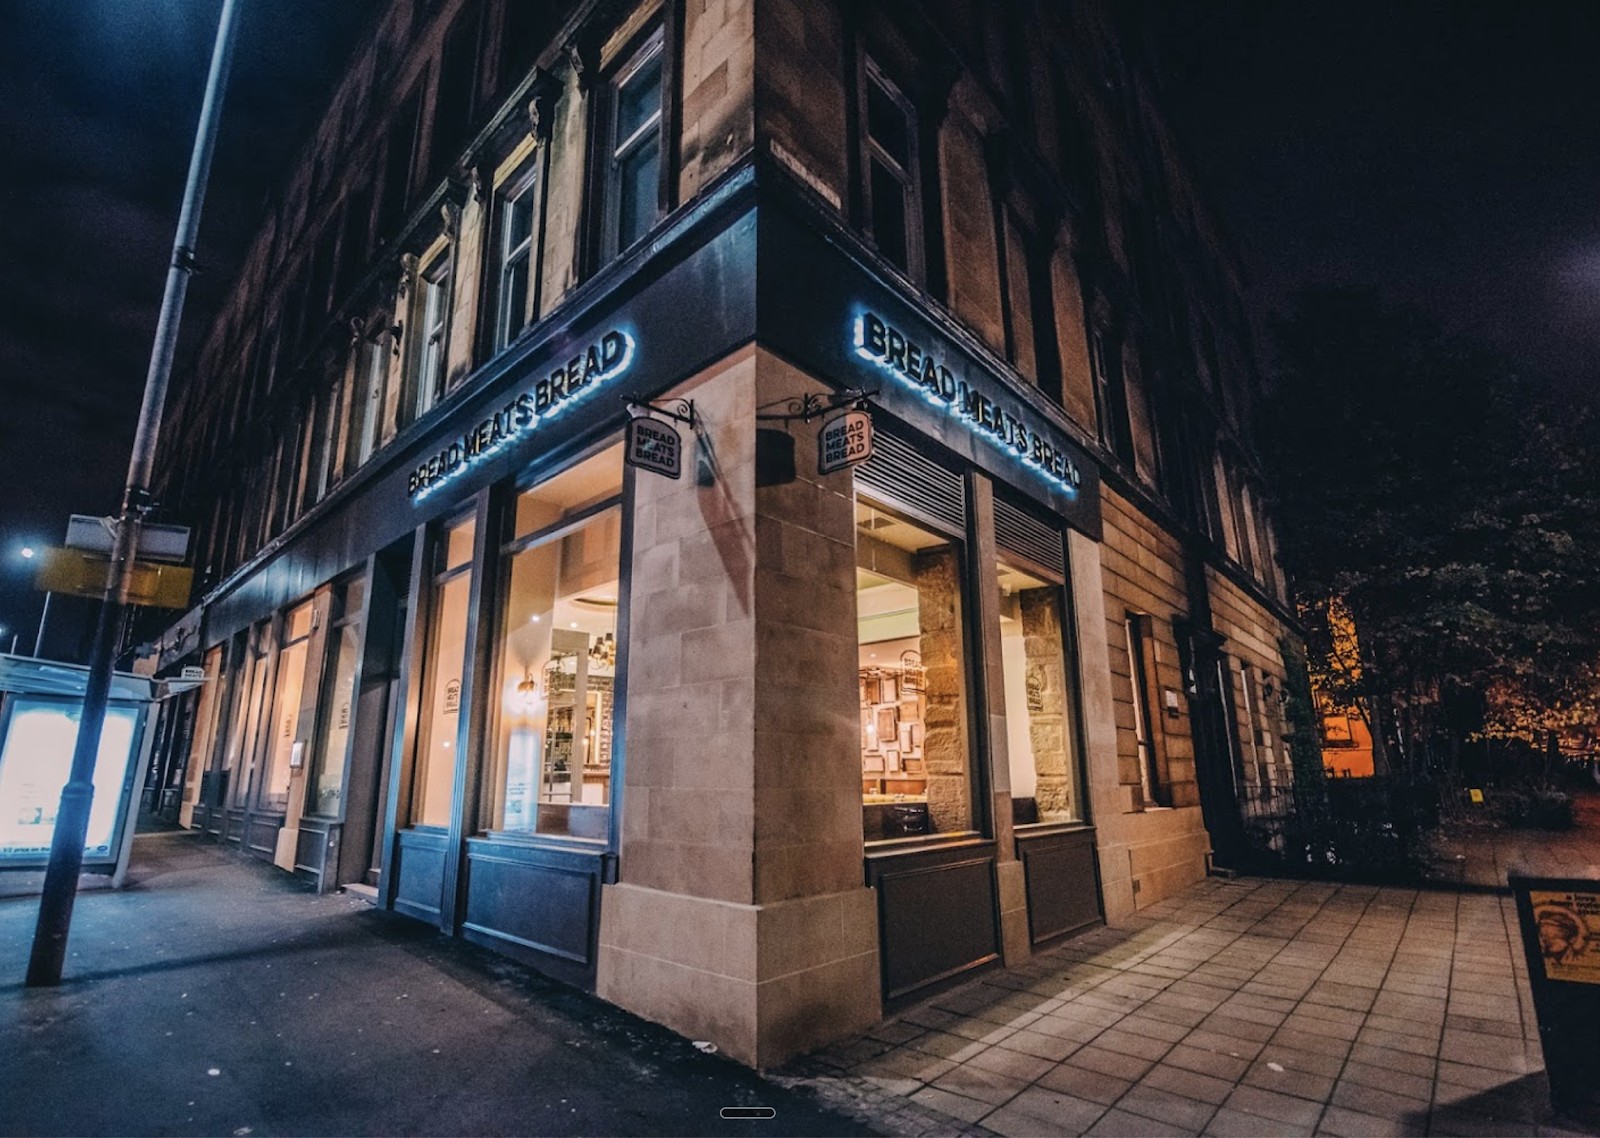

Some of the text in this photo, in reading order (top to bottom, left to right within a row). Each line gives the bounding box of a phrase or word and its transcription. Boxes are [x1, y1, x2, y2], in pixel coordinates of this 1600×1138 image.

[862, 312, 1080, 490] BREAD MEATS BREAD
[408, 330, 628, 498] BREAD MEATS BREAD
[637, 425, 675, 445] BREAD
[826, 420, 864, 441] BREAD
[636, 436, 674, 457] MEATS
[826, 432, 864, 452] MEATS
[636, 447, 674, 467] BREAD
[826, 443, 865, 463] BREAD
